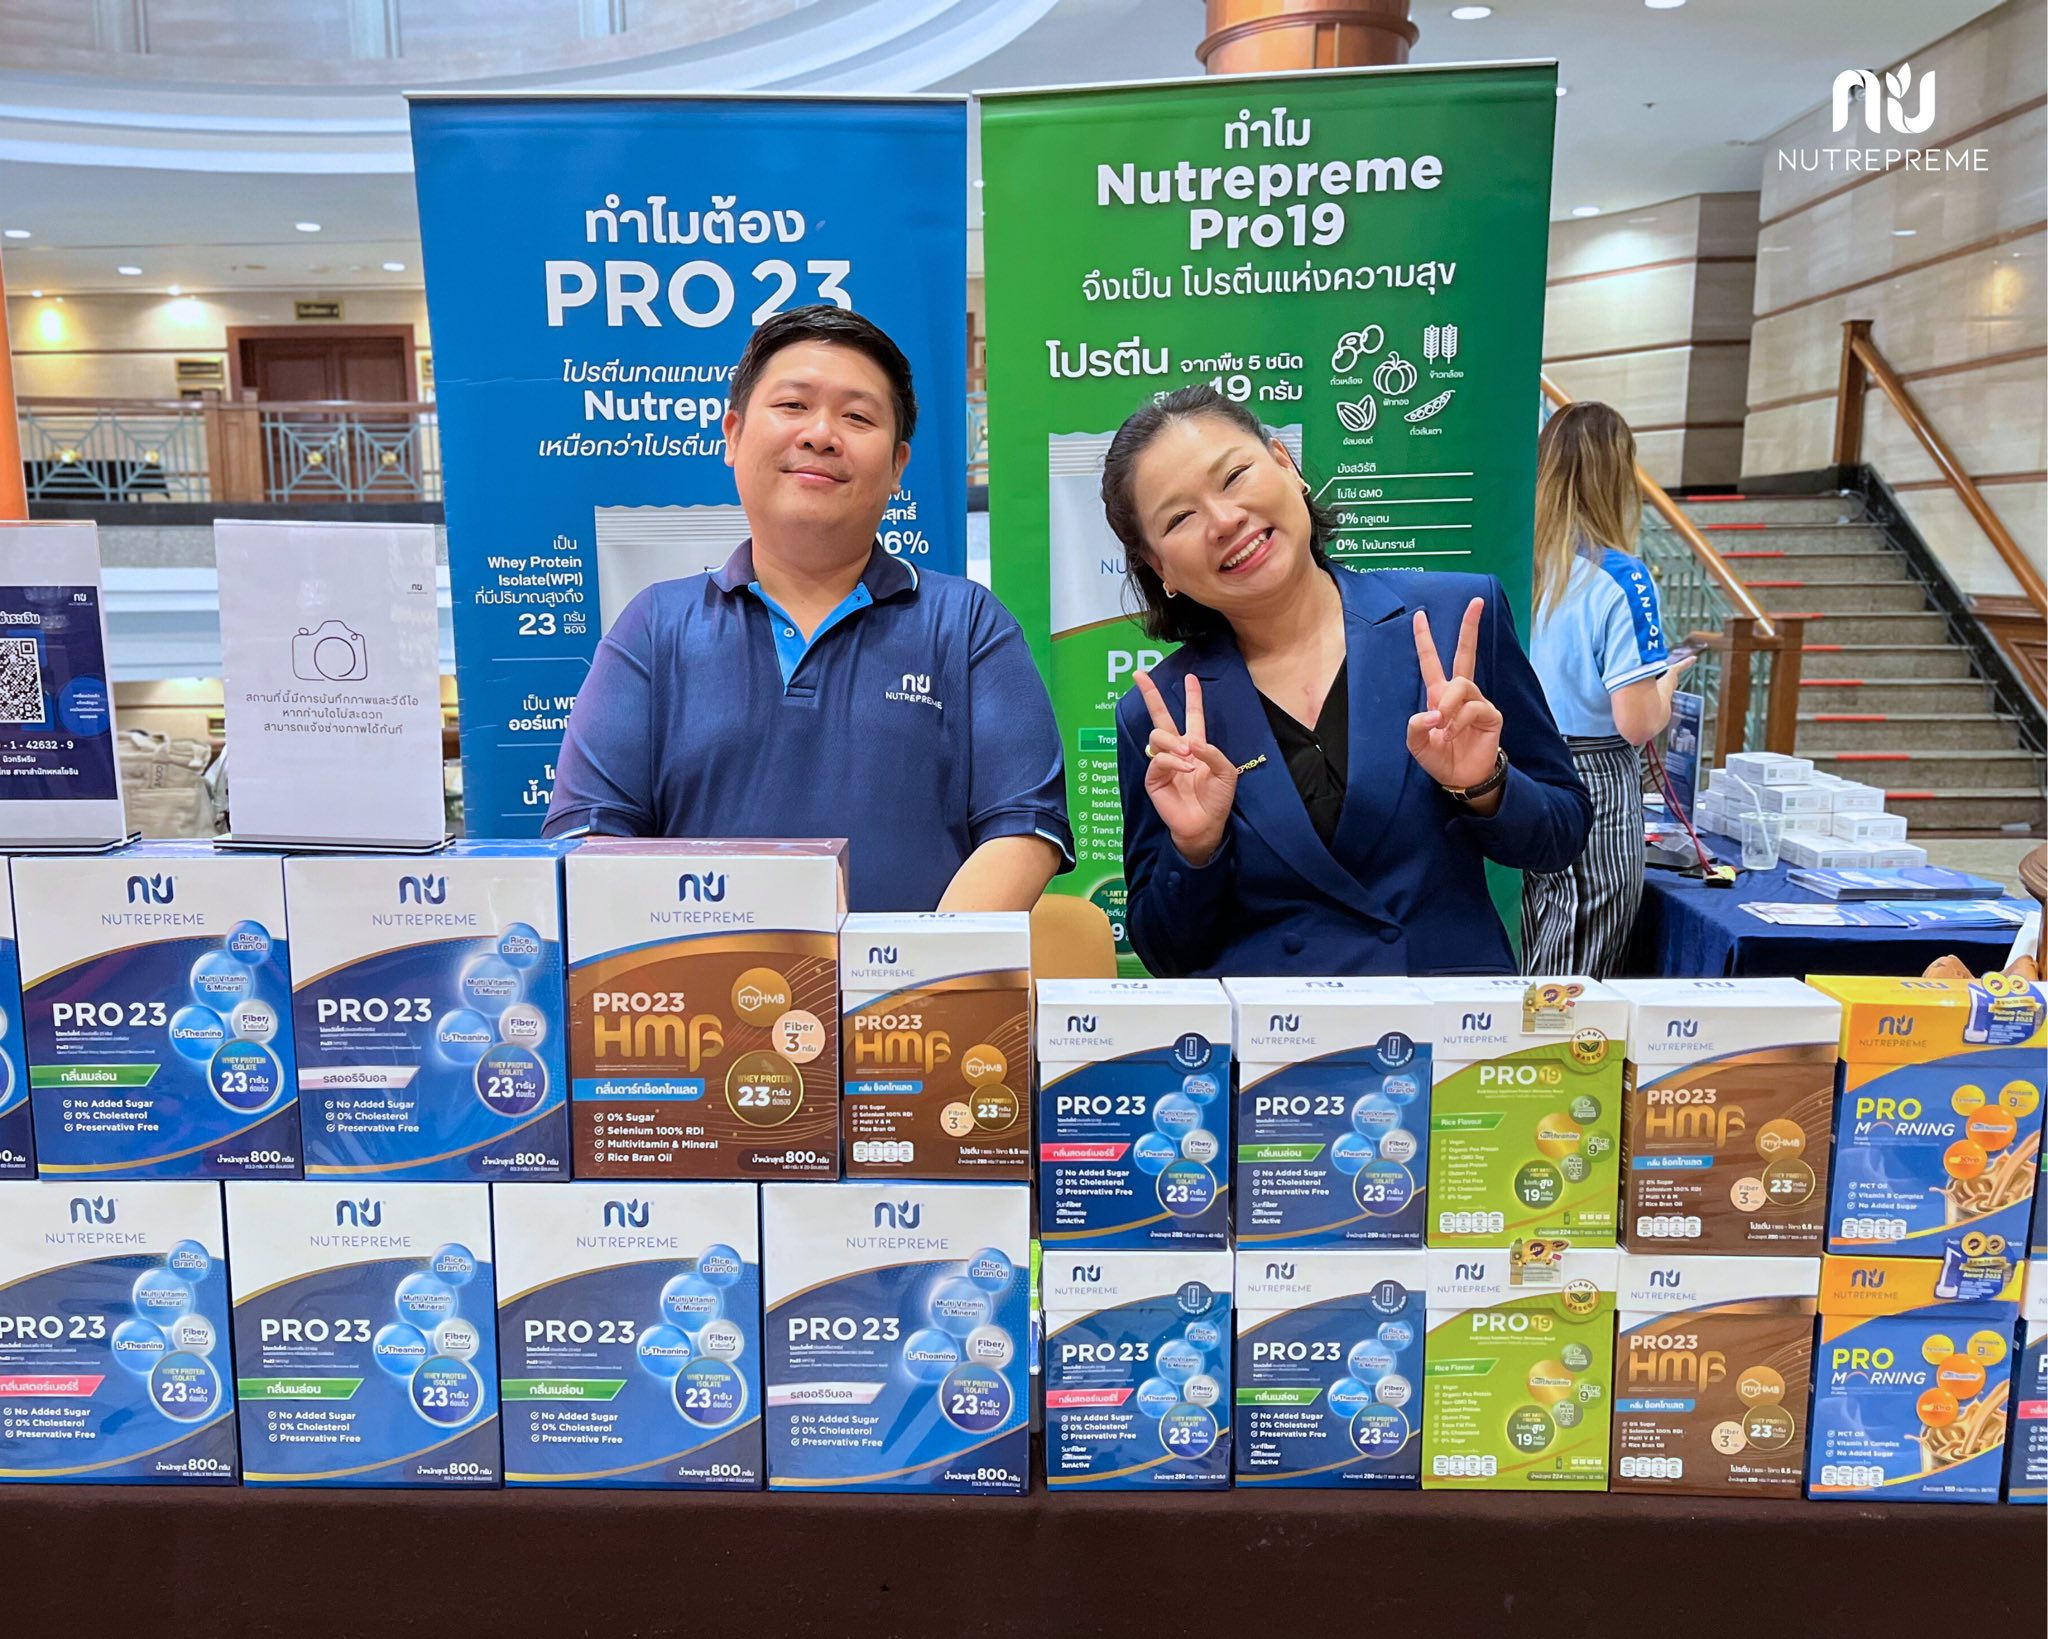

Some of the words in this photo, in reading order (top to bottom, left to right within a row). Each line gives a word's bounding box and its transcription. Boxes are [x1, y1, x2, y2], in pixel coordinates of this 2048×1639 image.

[1224, 108, 1311, 150] ทำไม
[1097, 154, 1443, 206] Nutrepreme
[585, 195, 805, 244] ทำไมต้อง
[1190, 203, 1345, 249] Pro19
[1082, 268, 1171, 302] จึงเป็น
[1182, 260, 1456, 298] โปรตีนแห่งความสุข
[1046, 337, 1168, 378] โปรตีน
[1180, 352, 1243, 373] จากพืช
[1248, 356, 1261, 369] 5
[1265, 352, 1303, 370] ชนิด
[1259, 379, 1302, 400] กรัม
[1359, 489, 1382, 498] GMO
[1337, 513, 1358, 524] 0%
[1360, 515, 1389, 526] กลูเตน
[553, 537, 577, 551] เป็น
[1336, 540, 1358, 550] 0%
[487, 557, 527, 570] Whey
[530, 556, 582, 568] Protein
[499, 572, 583, 587] Isolate(WPI)
[475, 587, 583, 608] ที่มีปริมาณสูงถึง
[1631, 570, 1659, 651] SANDOZ
[563, 611, 586, 623] กรัม
[518, 613, 557, 635] 23
[563, 625, 586, 634] ซอง
[523, 694, 550, 710] เป็น
[885, 690, 943, 710] NUTREPREME
[10, 741, 16, 749] 1
[26, 741, 57, 749] 42632
[67, 741, 73, 749] 9
[1092, 761, 1117, 770] Vegan
[523, 780, 554, 805] น้ำ
[1092, 813, 1119, 821] Gluten
[1092, 826, 1114, 834] Trans
[101, 913, 205, 925] NUTREPREME
[372, 913, 477, 926] NUTREPREME
[650, 911, 754, 923] NUTREPREME
[240, 934, 258, 942] Rice
[851, 969, 915, 977] NUTREPREME
[53, 1002, 124, 1027] PRO
[129, 1002, 167, 1026] 23
[317, 998, 389, 1023] PRO
[394, 998, 432, 1022] 23
[242, 1015, 266, 1023] Fiber
[784, 1022, 814, 1032] Fiber
[174, 1030, 222, 1039] L-Theanine
[785, 1034, 800, 1052] 3
[1050, 1038, 1113, 1046] NUTREPREME
[1251, 1037, 1315, 1045] NUTREPREME
[1859, 1039, 1927, 1048] NUTREPREME
[61, 1070, 117, 1083] กลิ่นเมล่อน
[222, 1073, 247, 1092] 23
[738, 1086, 770, 1107] 23
[75, 1100, 88, 1108] No
[91, 1100, 123, 1108] Added
[125, 1100, 153, 1109] Sugar
[1856, 1098, 1921, 1121] PRO
[607, 1113, 623, 1121] 0%
[626, 1113, 655, 1123] Sugar
[607, 1127, 653, 1135] Selenium
[656, 1127, 684, 1135] 100%
[686, 1127, 704, 1135] RDI
[608, 1140, 669, 1149] Multivitamin
[672, 1141, 679, 1149] &
[682, 1141, 718, 1149] Mineral
[250, 1151, 280, 1163] 800
[608, 1153, 630, 1162] Rice
[632, 1153, 655, 1162] Bran
[658, 1153, 672, 1162] Oil
[785, 1152, 816, 1164] 800
[46, 1233, 146, 1244] NUTREPREME
[310, 1236, 411, 1247] NUTREPREME
[577, 1237, 678, 1248] NUTREPREME
[847, 1238, 949, 1249] NUTREPREME
[1055, 1287, 1117, 1295] NUTREPREME
[1834, 1292, 1897, 1300] NUTREPREME
[789, 1318, 857, 1341] PRO
[862, 1318, 900, 1341] 23
[1832, 1348, 1894, 1370] PRO
